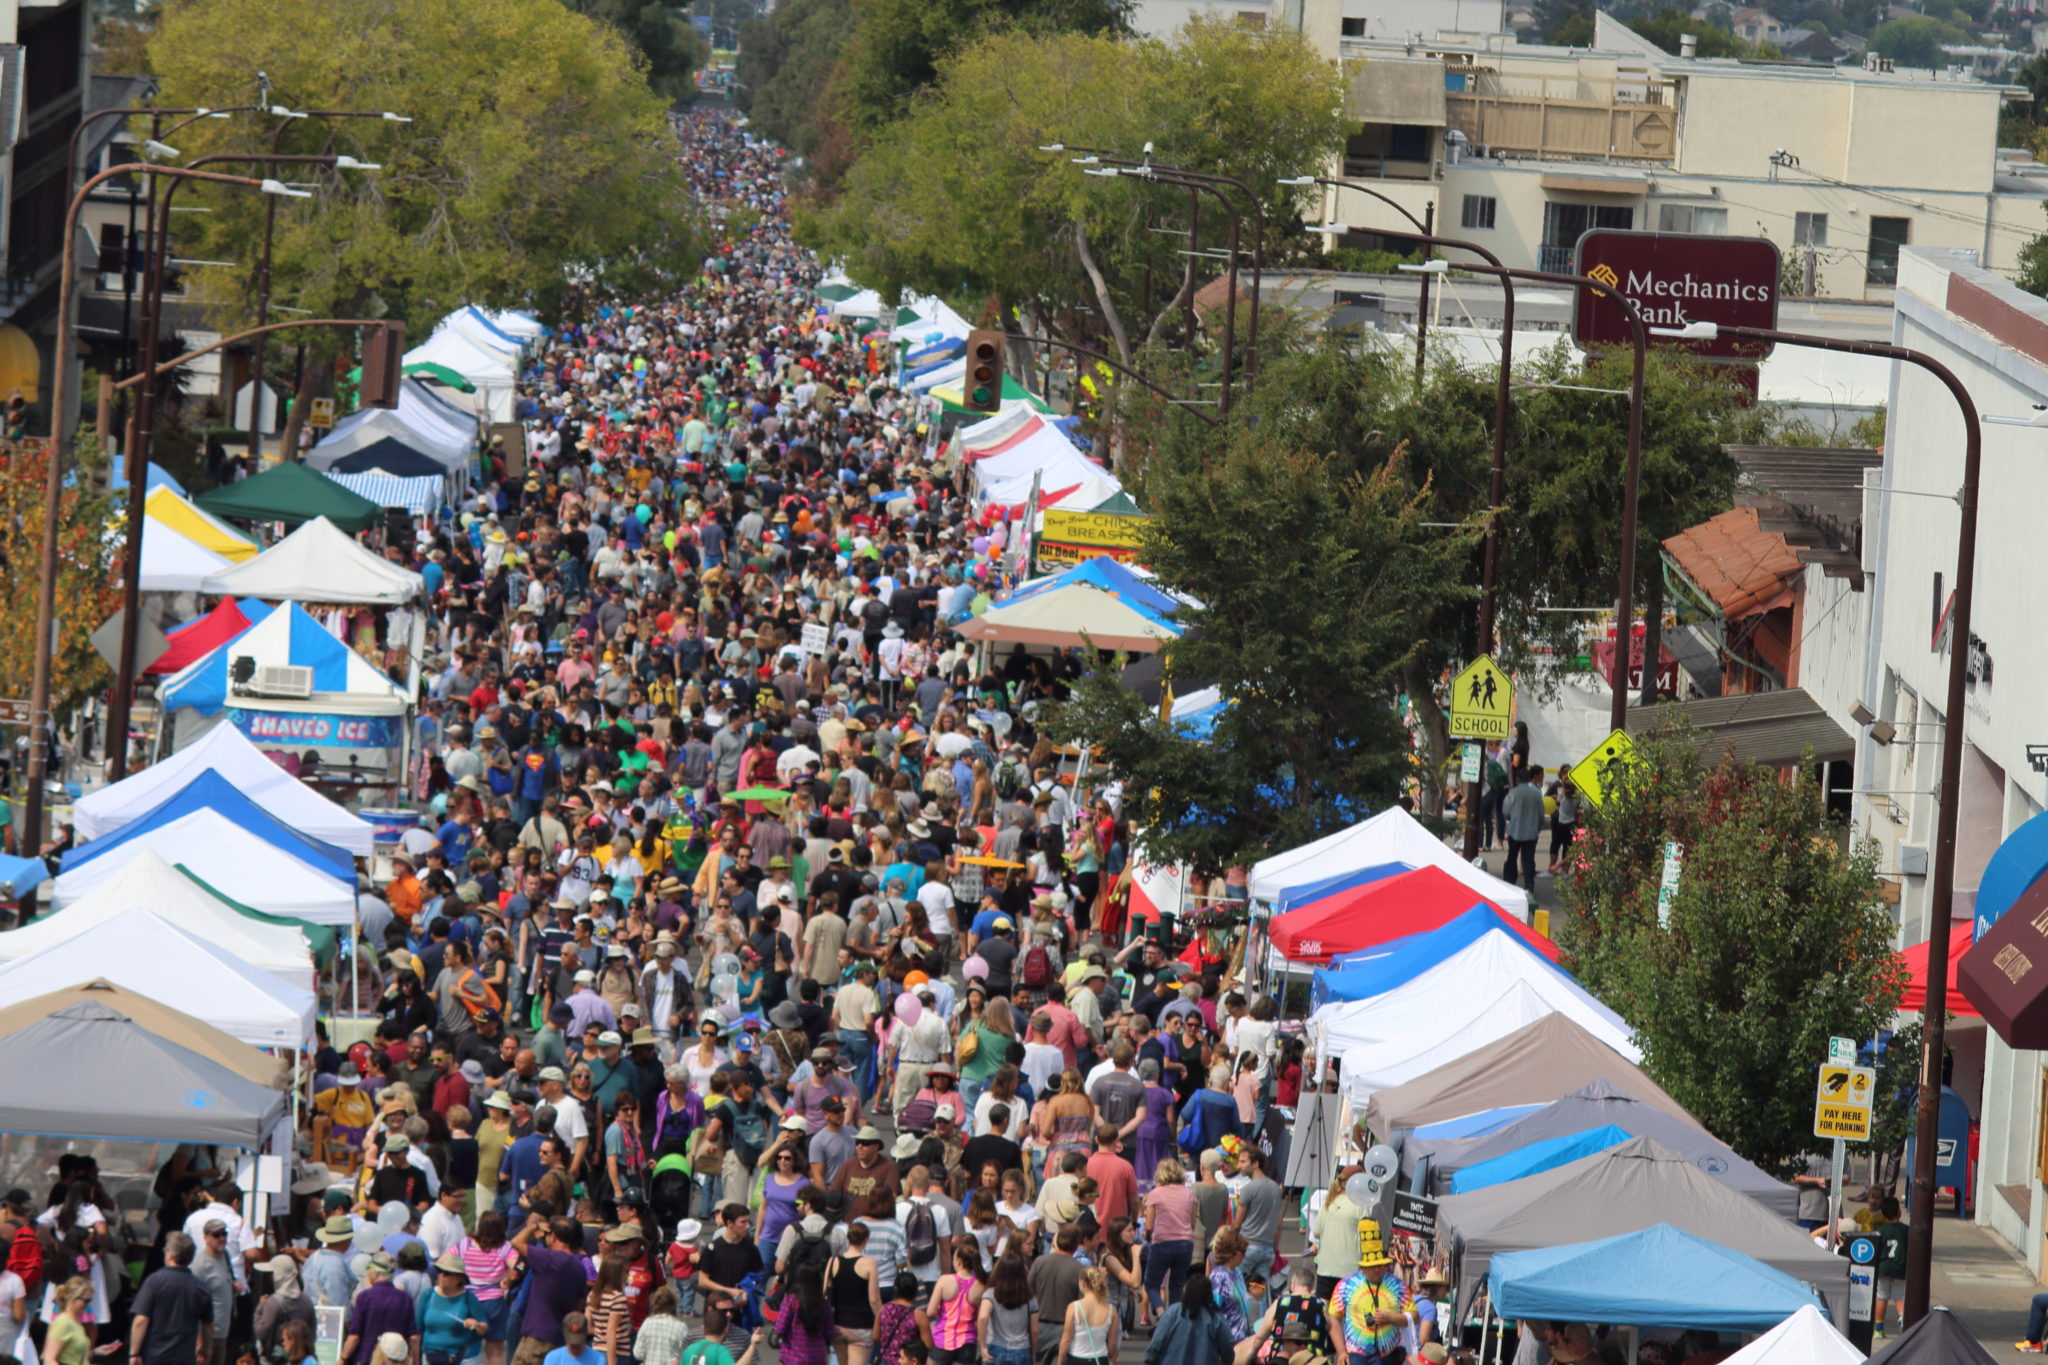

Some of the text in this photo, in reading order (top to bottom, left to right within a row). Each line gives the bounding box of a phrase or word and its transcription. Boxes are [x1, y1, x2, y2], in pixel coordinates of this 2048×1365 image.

[1625, 269, 1769, 301] Mechanics
[1624, 298, 1688, 325] Bank
[250, 715, 369, 742] SHAVED ICE
[1455, 717, 1505, 733] SCHOOL
[1830, 1041, 1838, 1055] 2
[1856, 1073, 1865, 1085] 2
[1824, 1108, 1863, 1121] PAY HERE
[1820, 1120, 1866, 1134] FOR PARKING
[1857, 1243, 1869, 1258] P
[1886, 1239, 1898, 1258] 7
